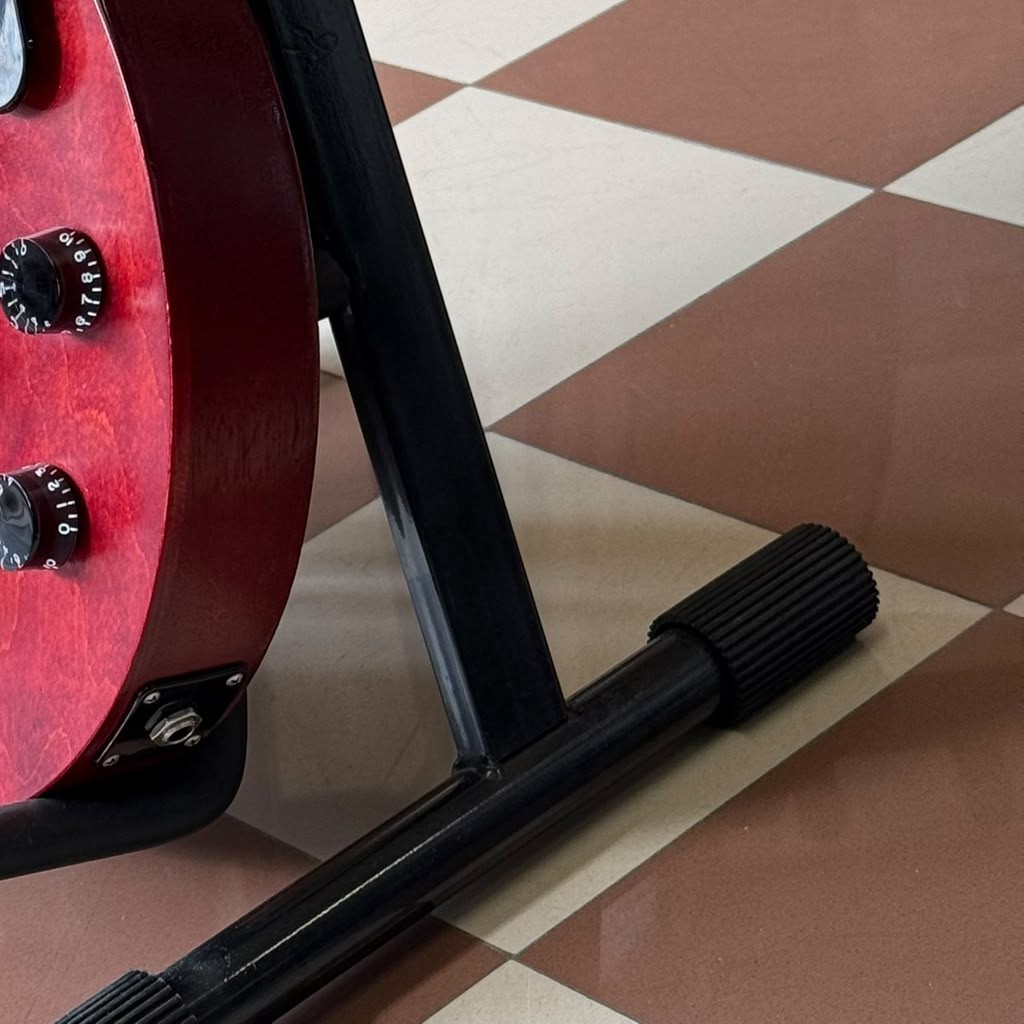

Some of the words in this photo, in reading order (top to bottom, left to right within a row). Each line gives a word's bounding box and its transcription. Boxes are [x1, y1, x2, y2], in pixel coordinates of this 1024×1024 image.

[81, 272, 93, 284] 8
[81, 294, 93, 305] 7
[47, 479, 60, 492] 2
